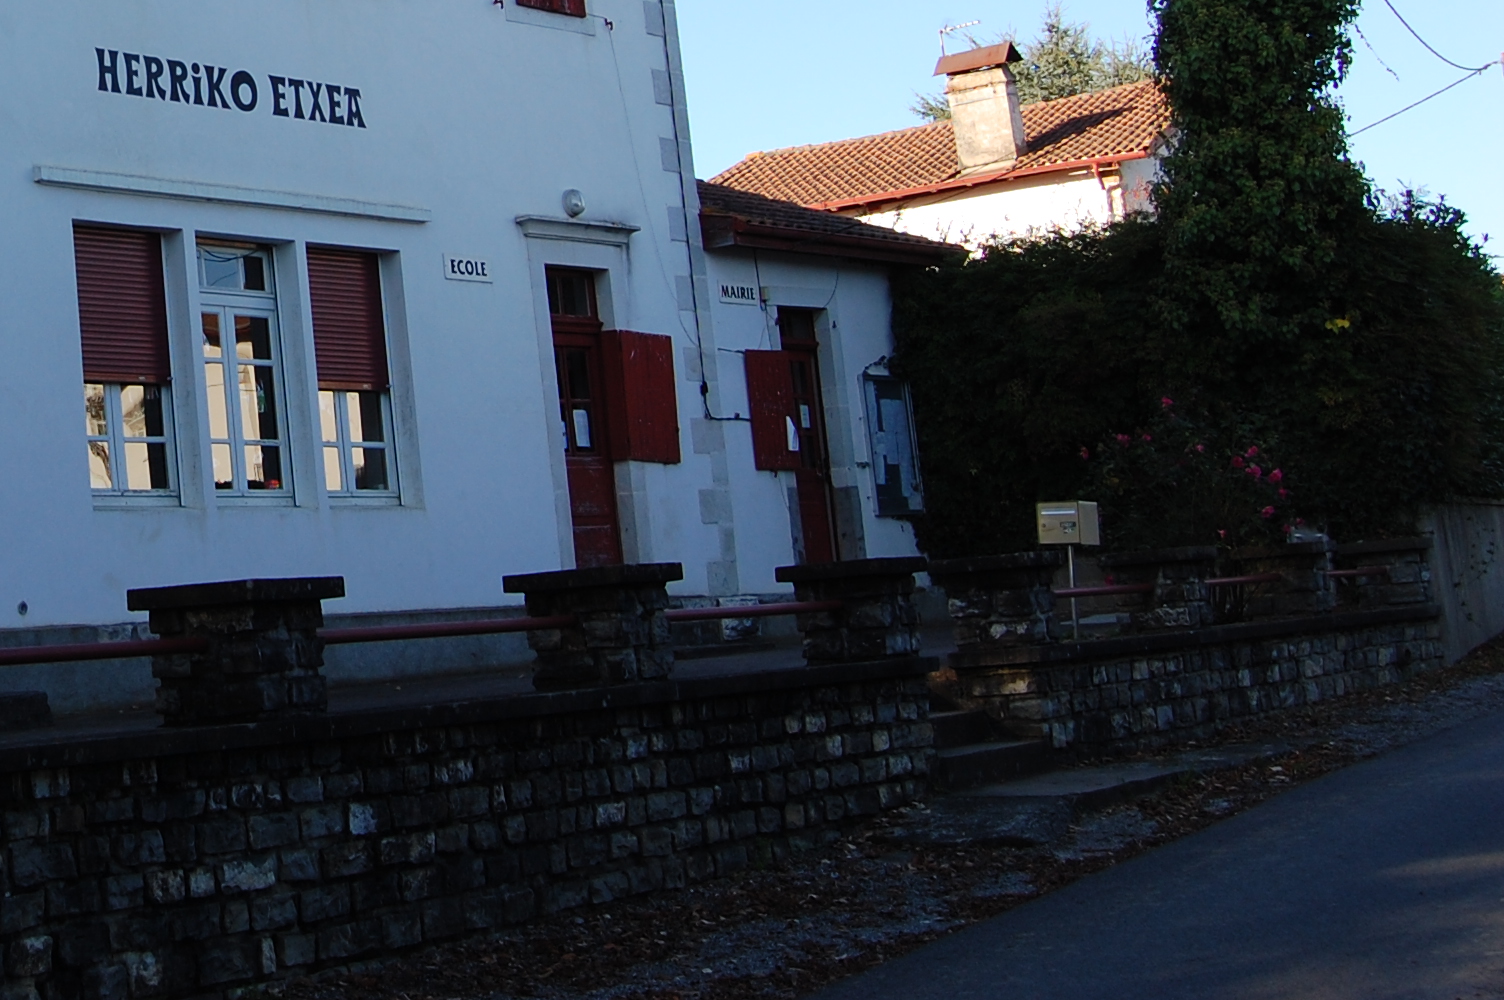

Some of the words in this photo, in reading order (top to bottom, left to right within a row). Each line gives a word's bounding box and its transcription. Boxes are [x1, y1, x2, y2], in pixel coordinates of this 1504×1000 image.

[268, 74, 367, 128] ETXEA
[450, 258, 488, 277] ECOLE
[721, 284, 756, 301] MAIRIE
